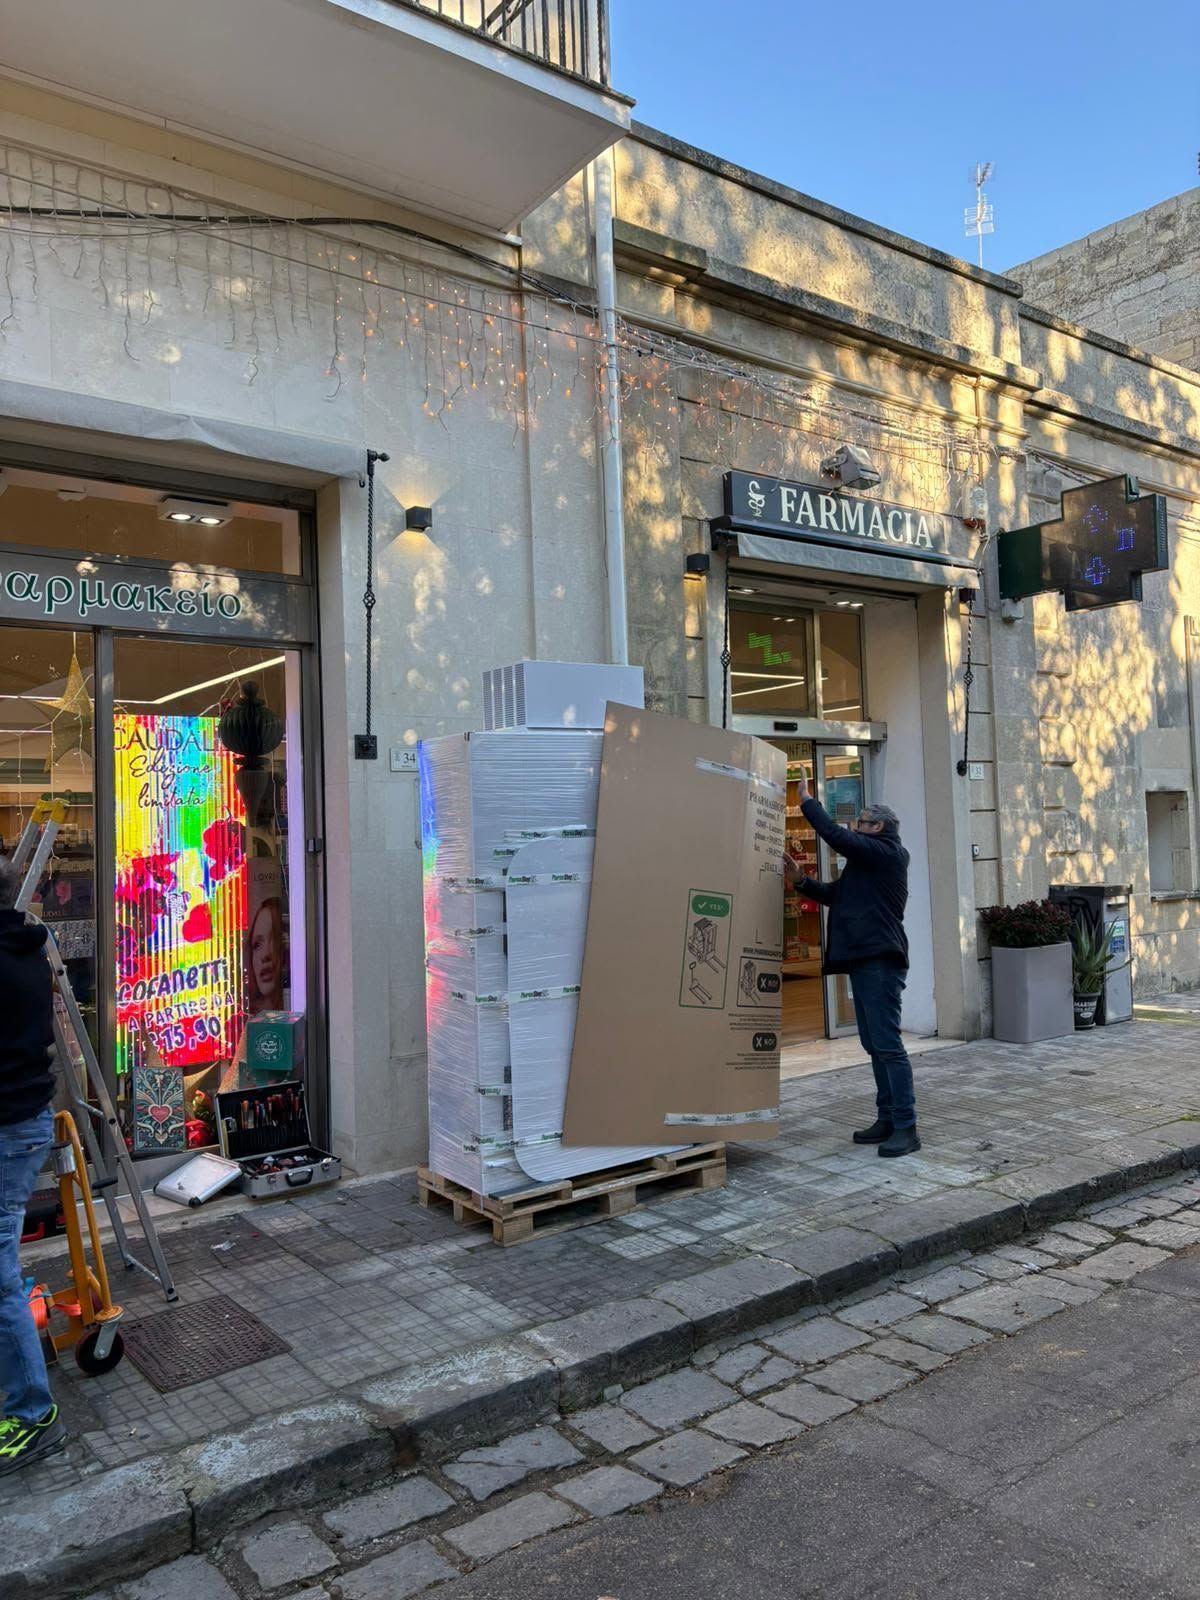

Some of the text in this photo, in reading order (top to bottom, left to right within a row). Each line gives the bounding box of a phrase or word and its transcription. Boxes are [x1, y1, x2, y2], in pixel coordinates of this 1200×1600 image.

[779, 486, 933, 548] FARMACIA
[0, 570, 242, 618] αρμακείο
[129, 748, 212, 790] Edizione
[403, 752, 416, 763] 34
[138, 783, 207, 809] limitata
